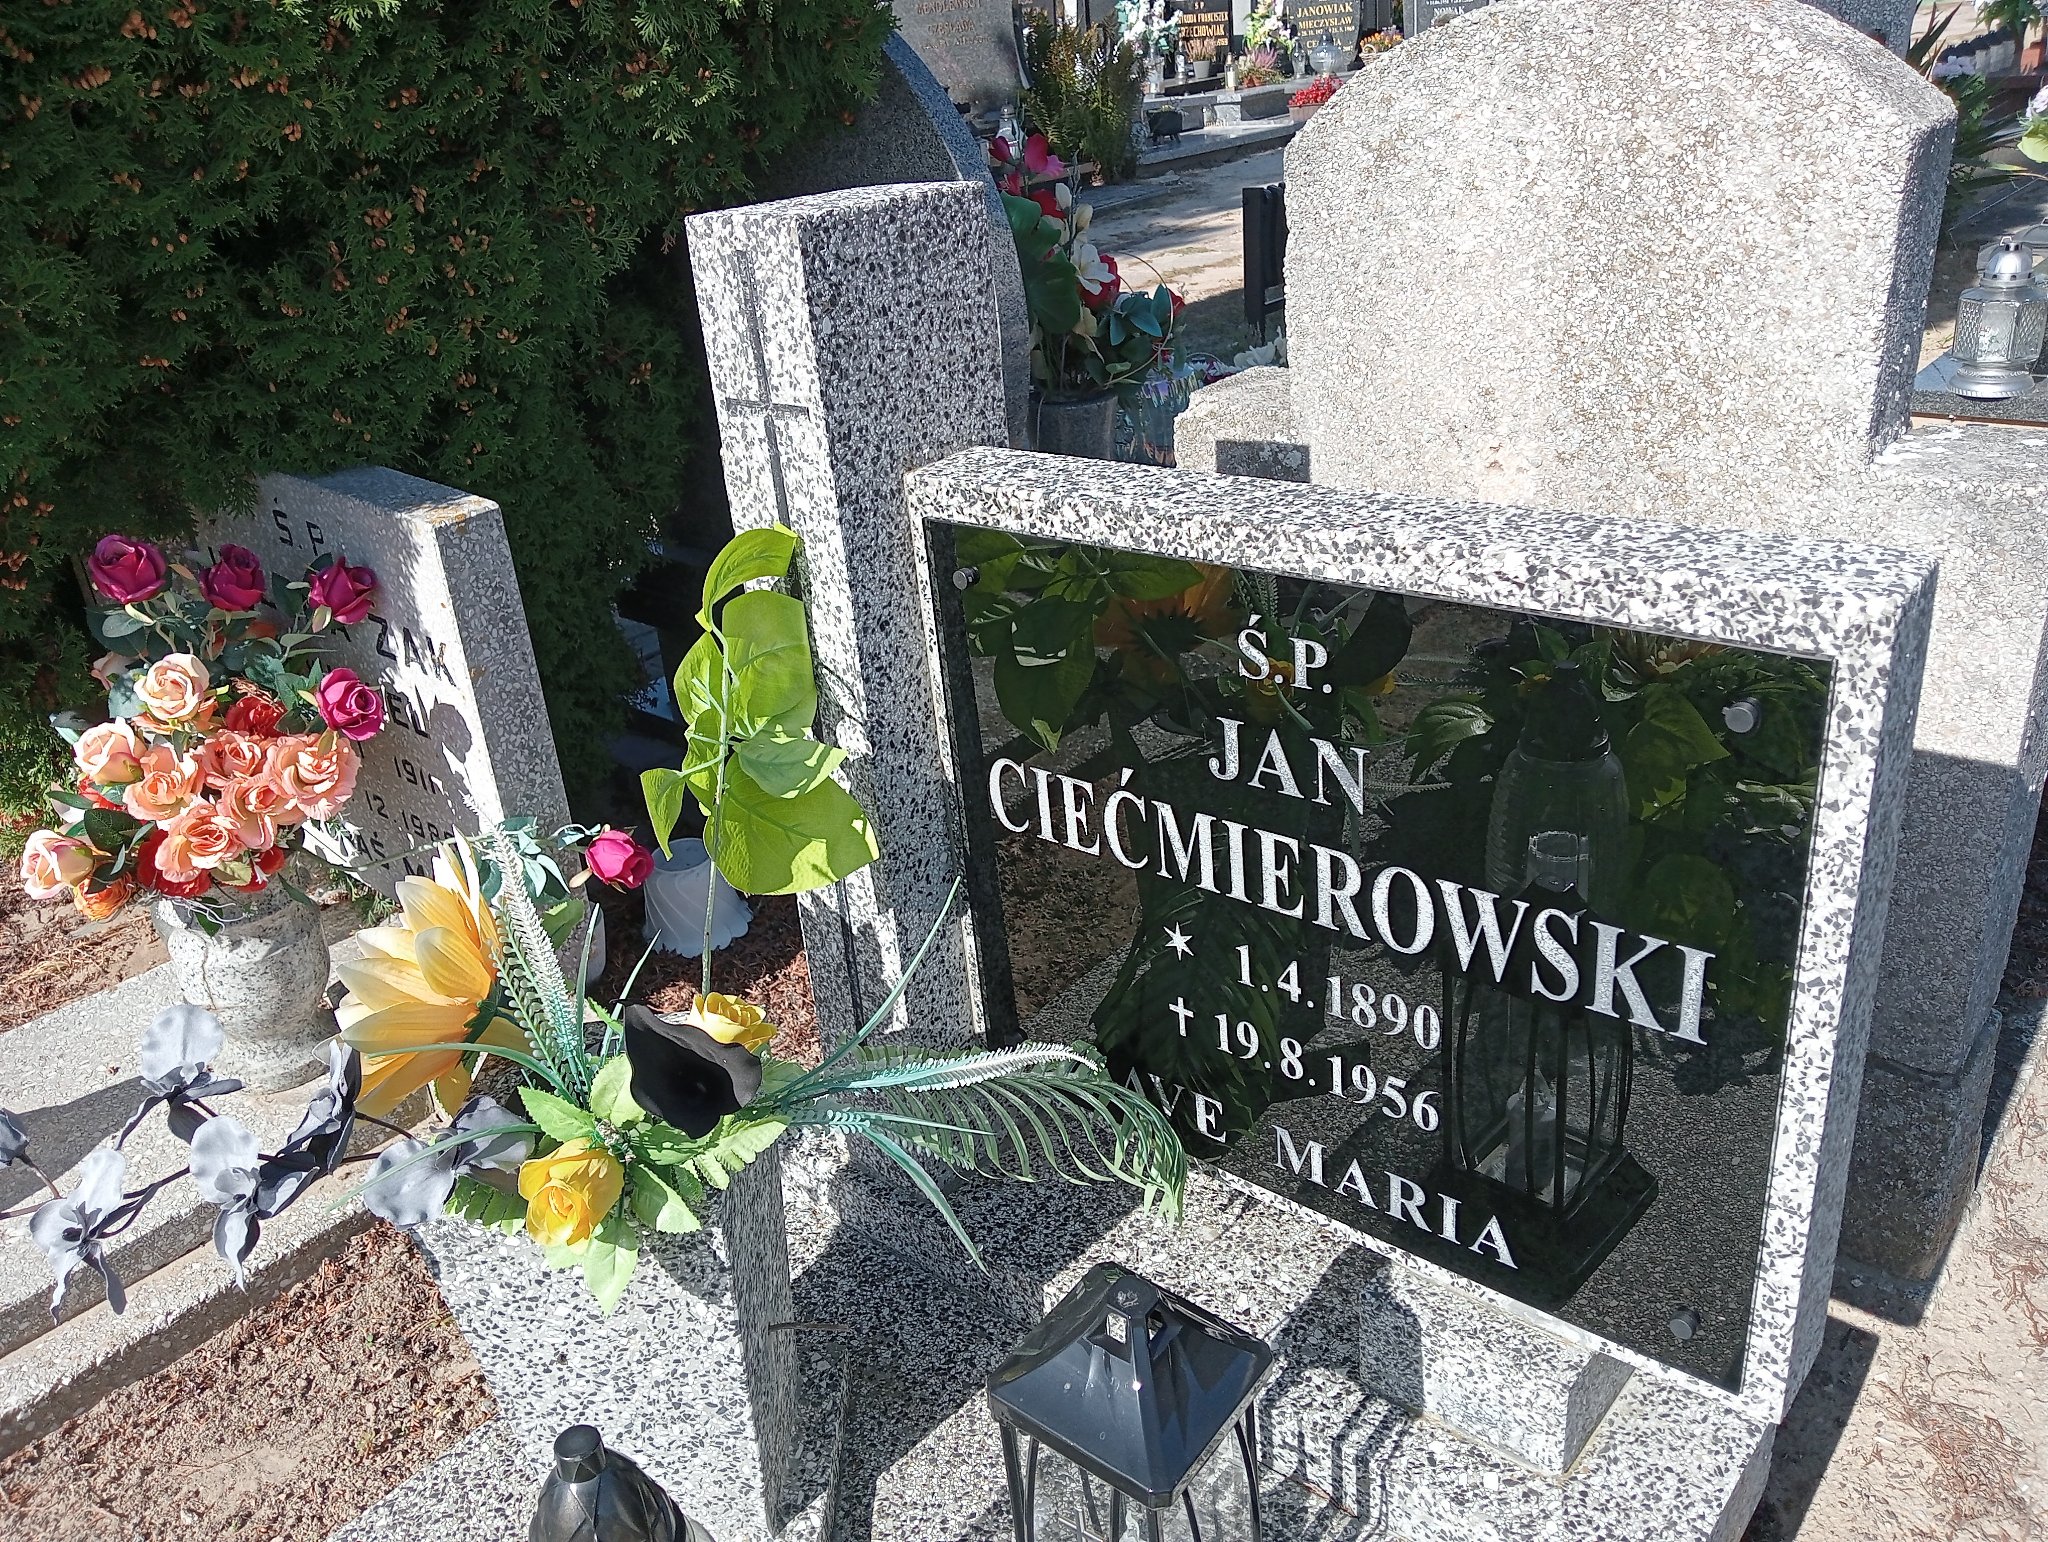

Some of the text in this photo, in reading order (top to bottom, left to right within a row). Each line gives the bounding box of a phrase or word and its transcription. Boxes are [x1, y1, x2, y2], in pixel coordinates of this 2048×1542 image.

[1296, 2, 1353, 18] JANOWIAK
[1236, 615, 1333, 694] Ś.P.
[1208, 716, 1370, 816] JAN
[988, 757, 1717, 1047] CIEĆMIEROWSKI
[1125, 1066, 1518, 1270] AVE MARIA
